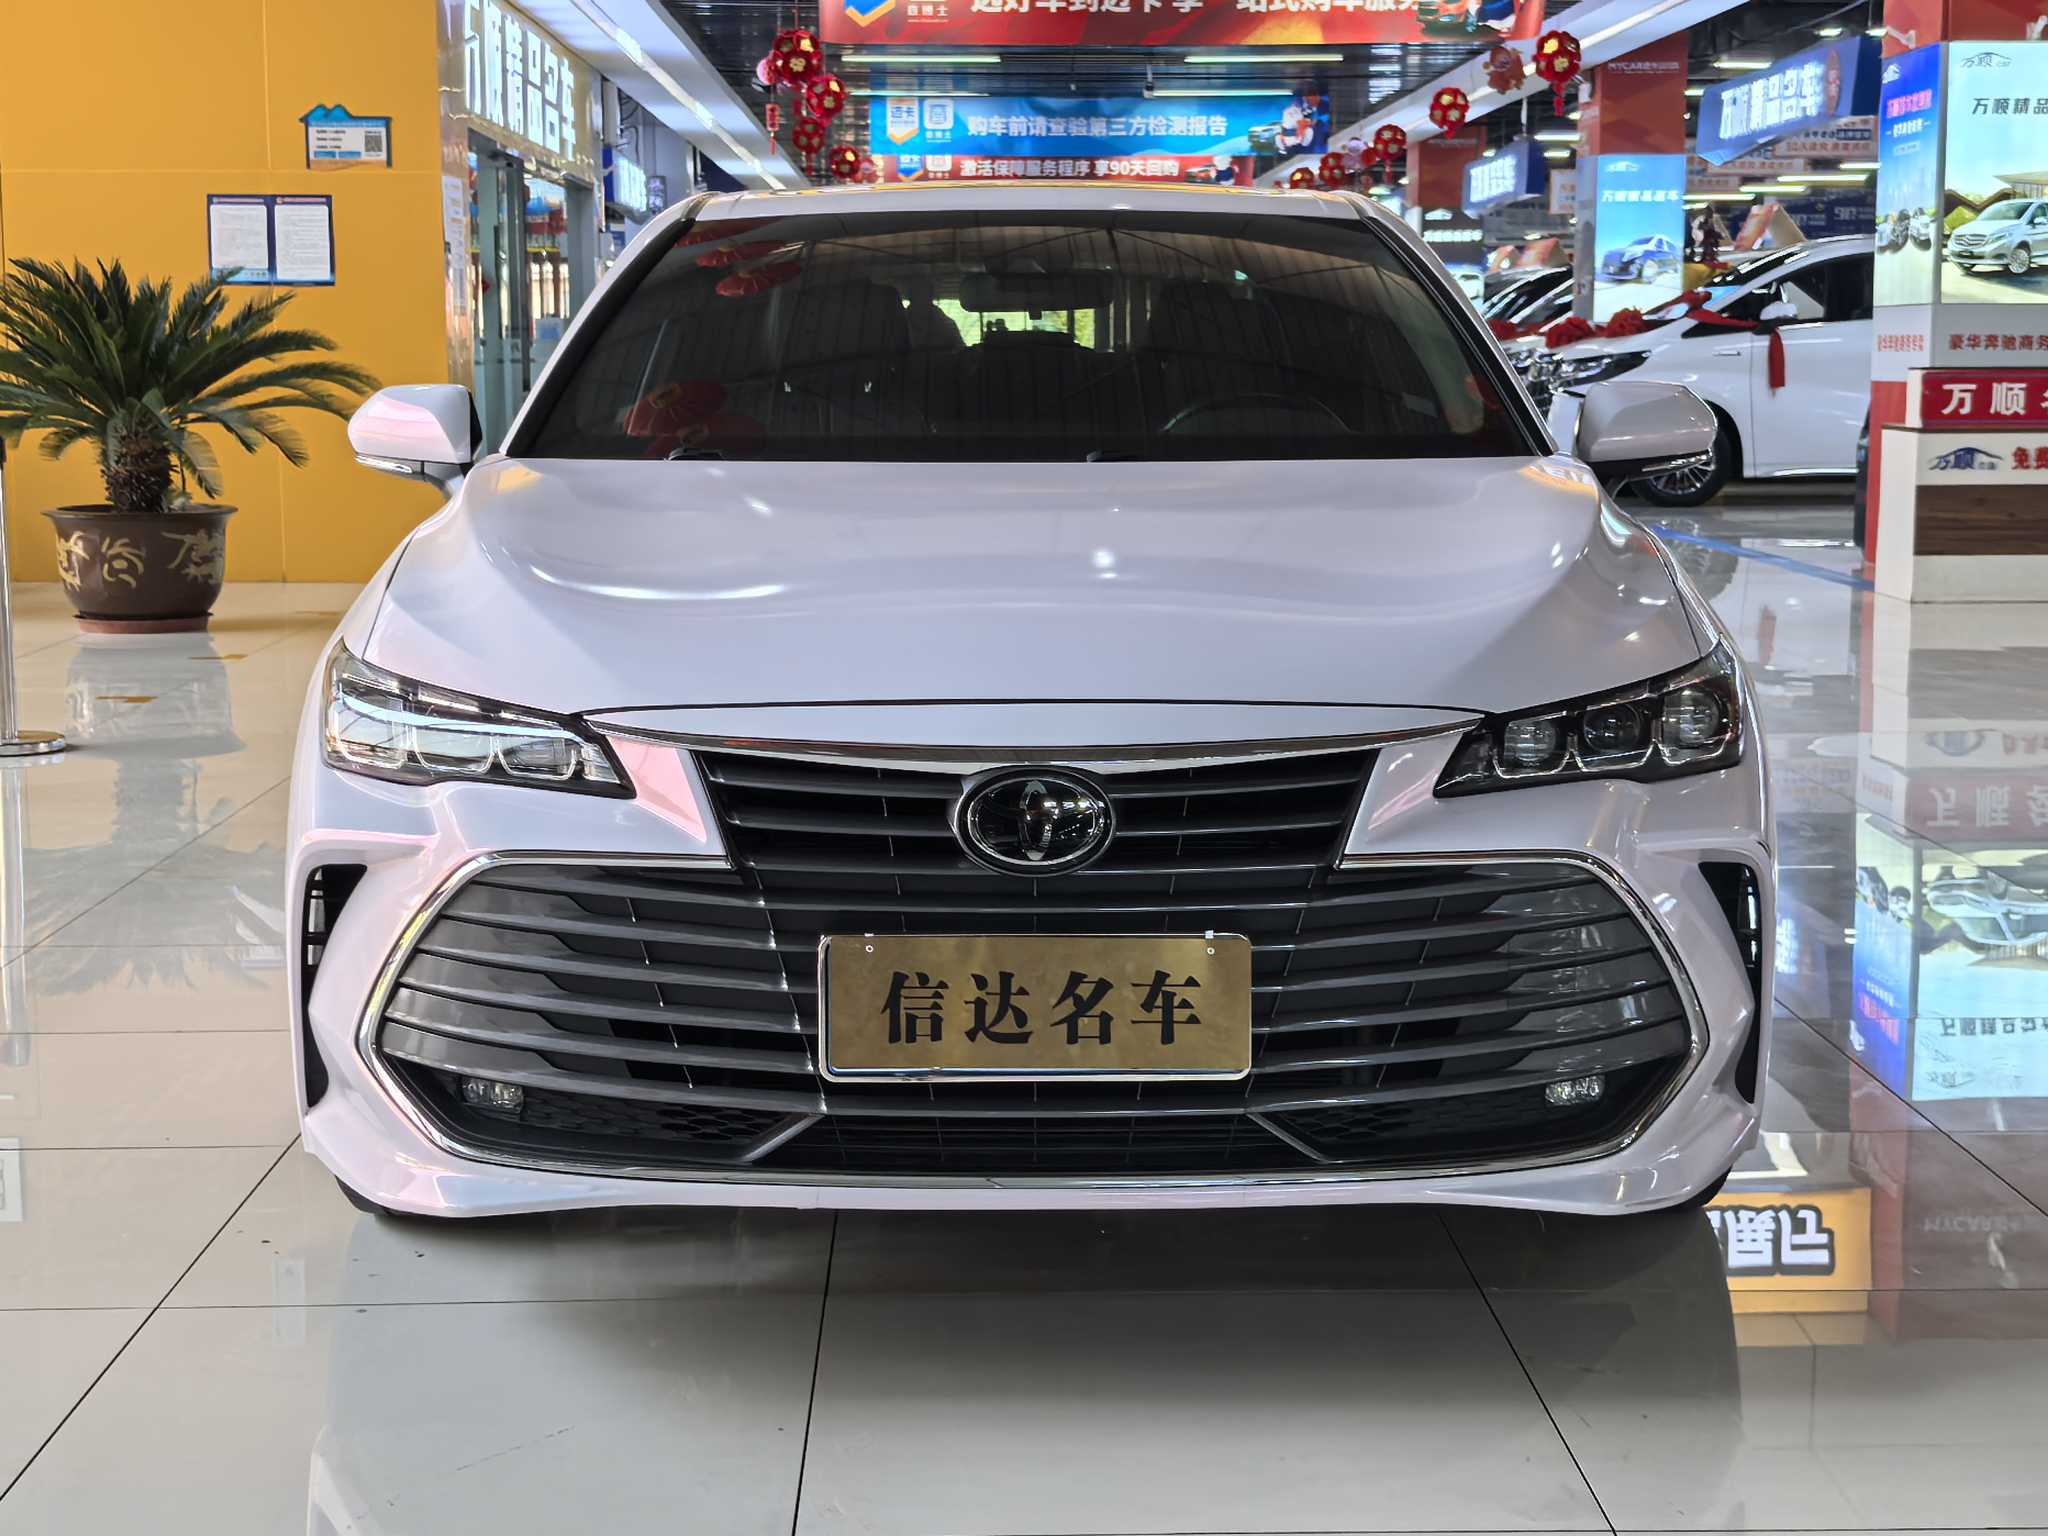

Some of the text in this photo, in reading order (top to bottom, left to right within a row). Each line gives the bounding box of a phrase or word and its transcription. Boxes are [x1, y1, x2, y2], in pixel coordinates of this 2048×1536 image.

[968, 115, 1228, 138] 购车前请查验第三方检测报告
[1941, 382, 2048, 416] 万顺
[880, 969, 1202, 1045] 信达名车
